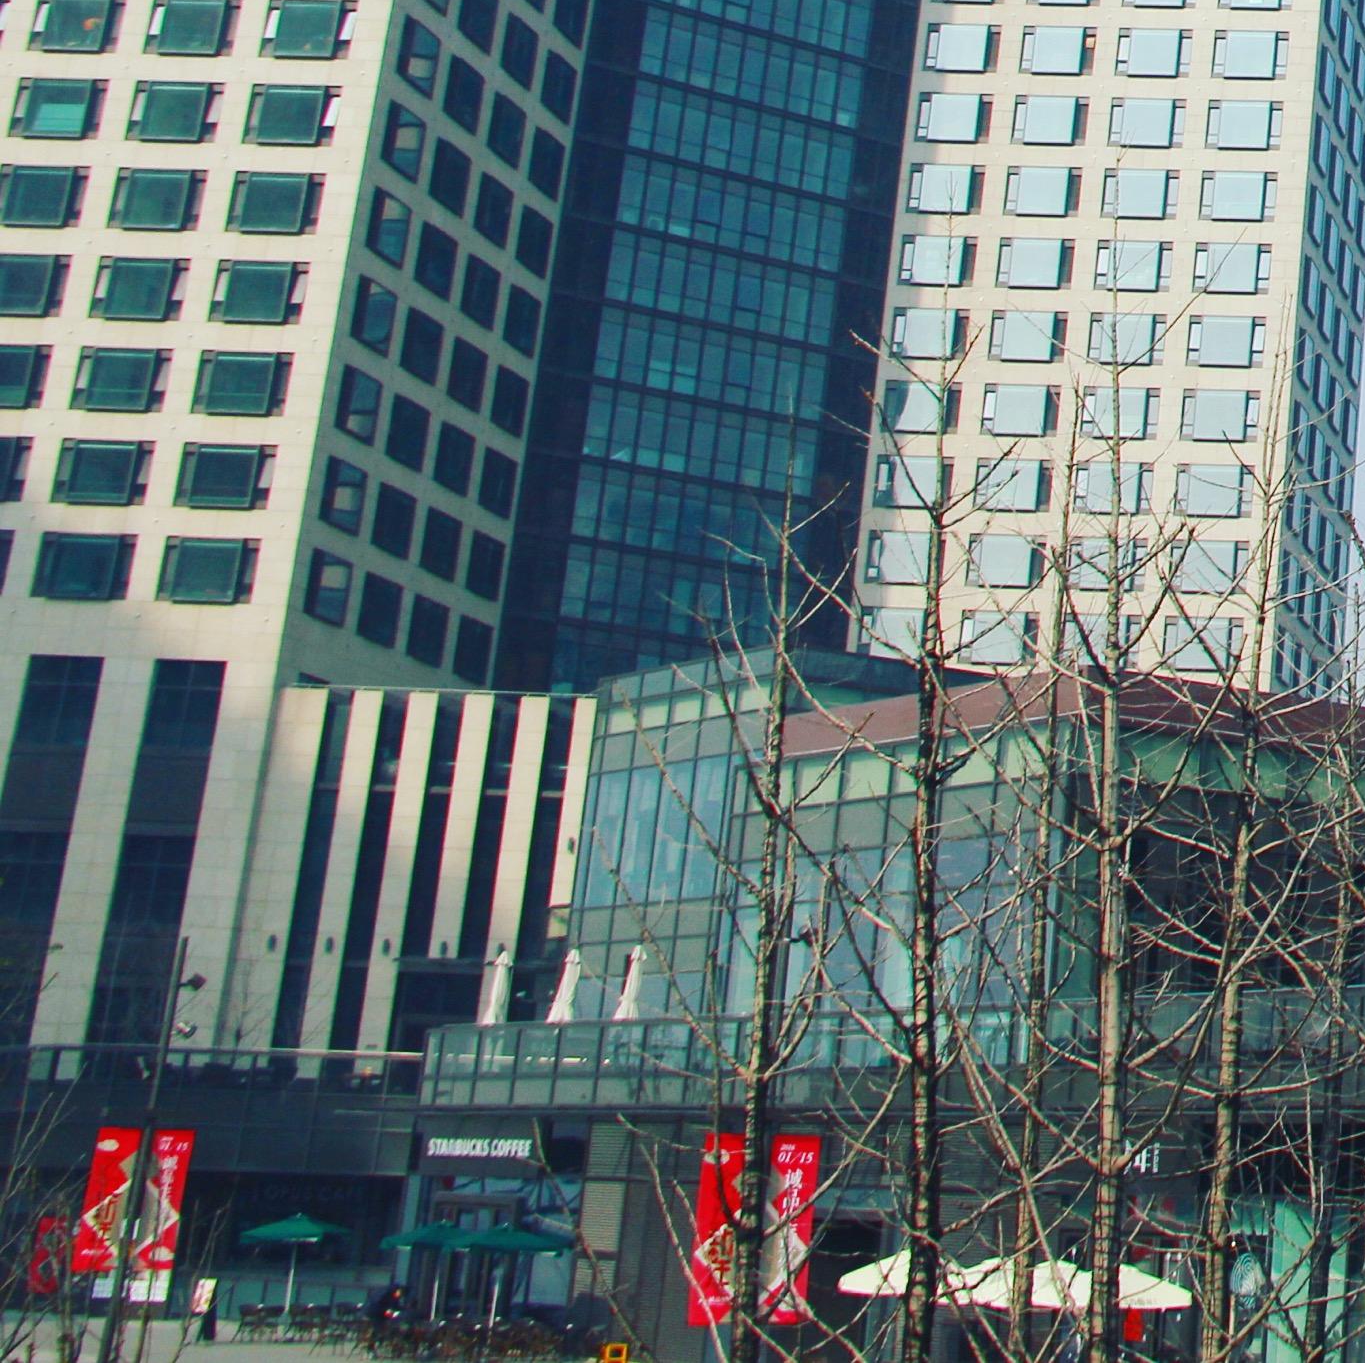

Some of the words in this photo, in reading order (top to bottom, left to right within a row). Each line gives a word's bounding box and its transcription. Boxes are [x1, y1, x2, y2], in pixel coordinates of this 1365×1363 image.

[427, 1137, 490, 1157] STARBUCKS
[490, 1138, 533, 1158] COFFEE
[777, 1151, 814, 1164] 01/15
